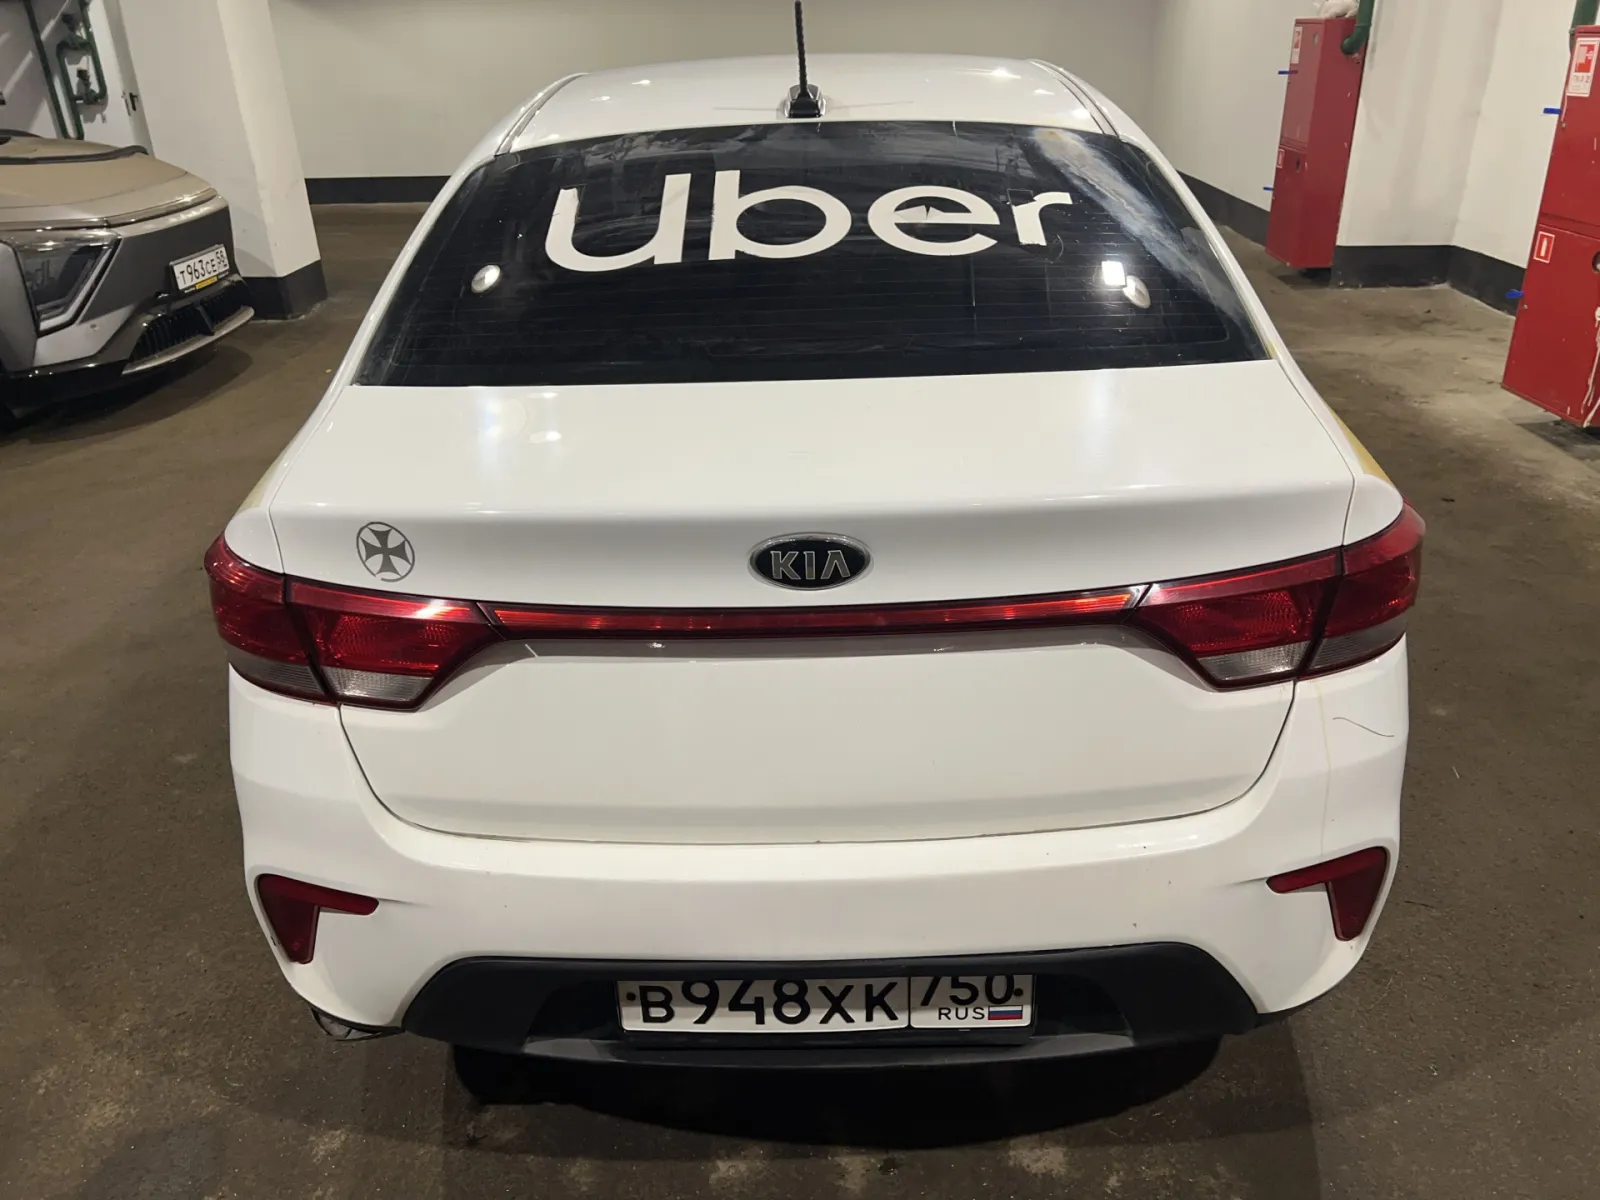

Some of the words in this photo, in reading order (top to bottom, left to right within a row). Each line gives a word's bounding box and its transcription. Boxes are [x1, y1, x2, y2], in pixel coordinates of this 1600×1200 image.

[544, 169, 1073, 273] uber
[770, 550, 851, 580] KIA
[639, 979, 899, 1025] В948ХК
[920, 975, 1015, 1006] 750
[938, 1006, 985, 1020] RUS
